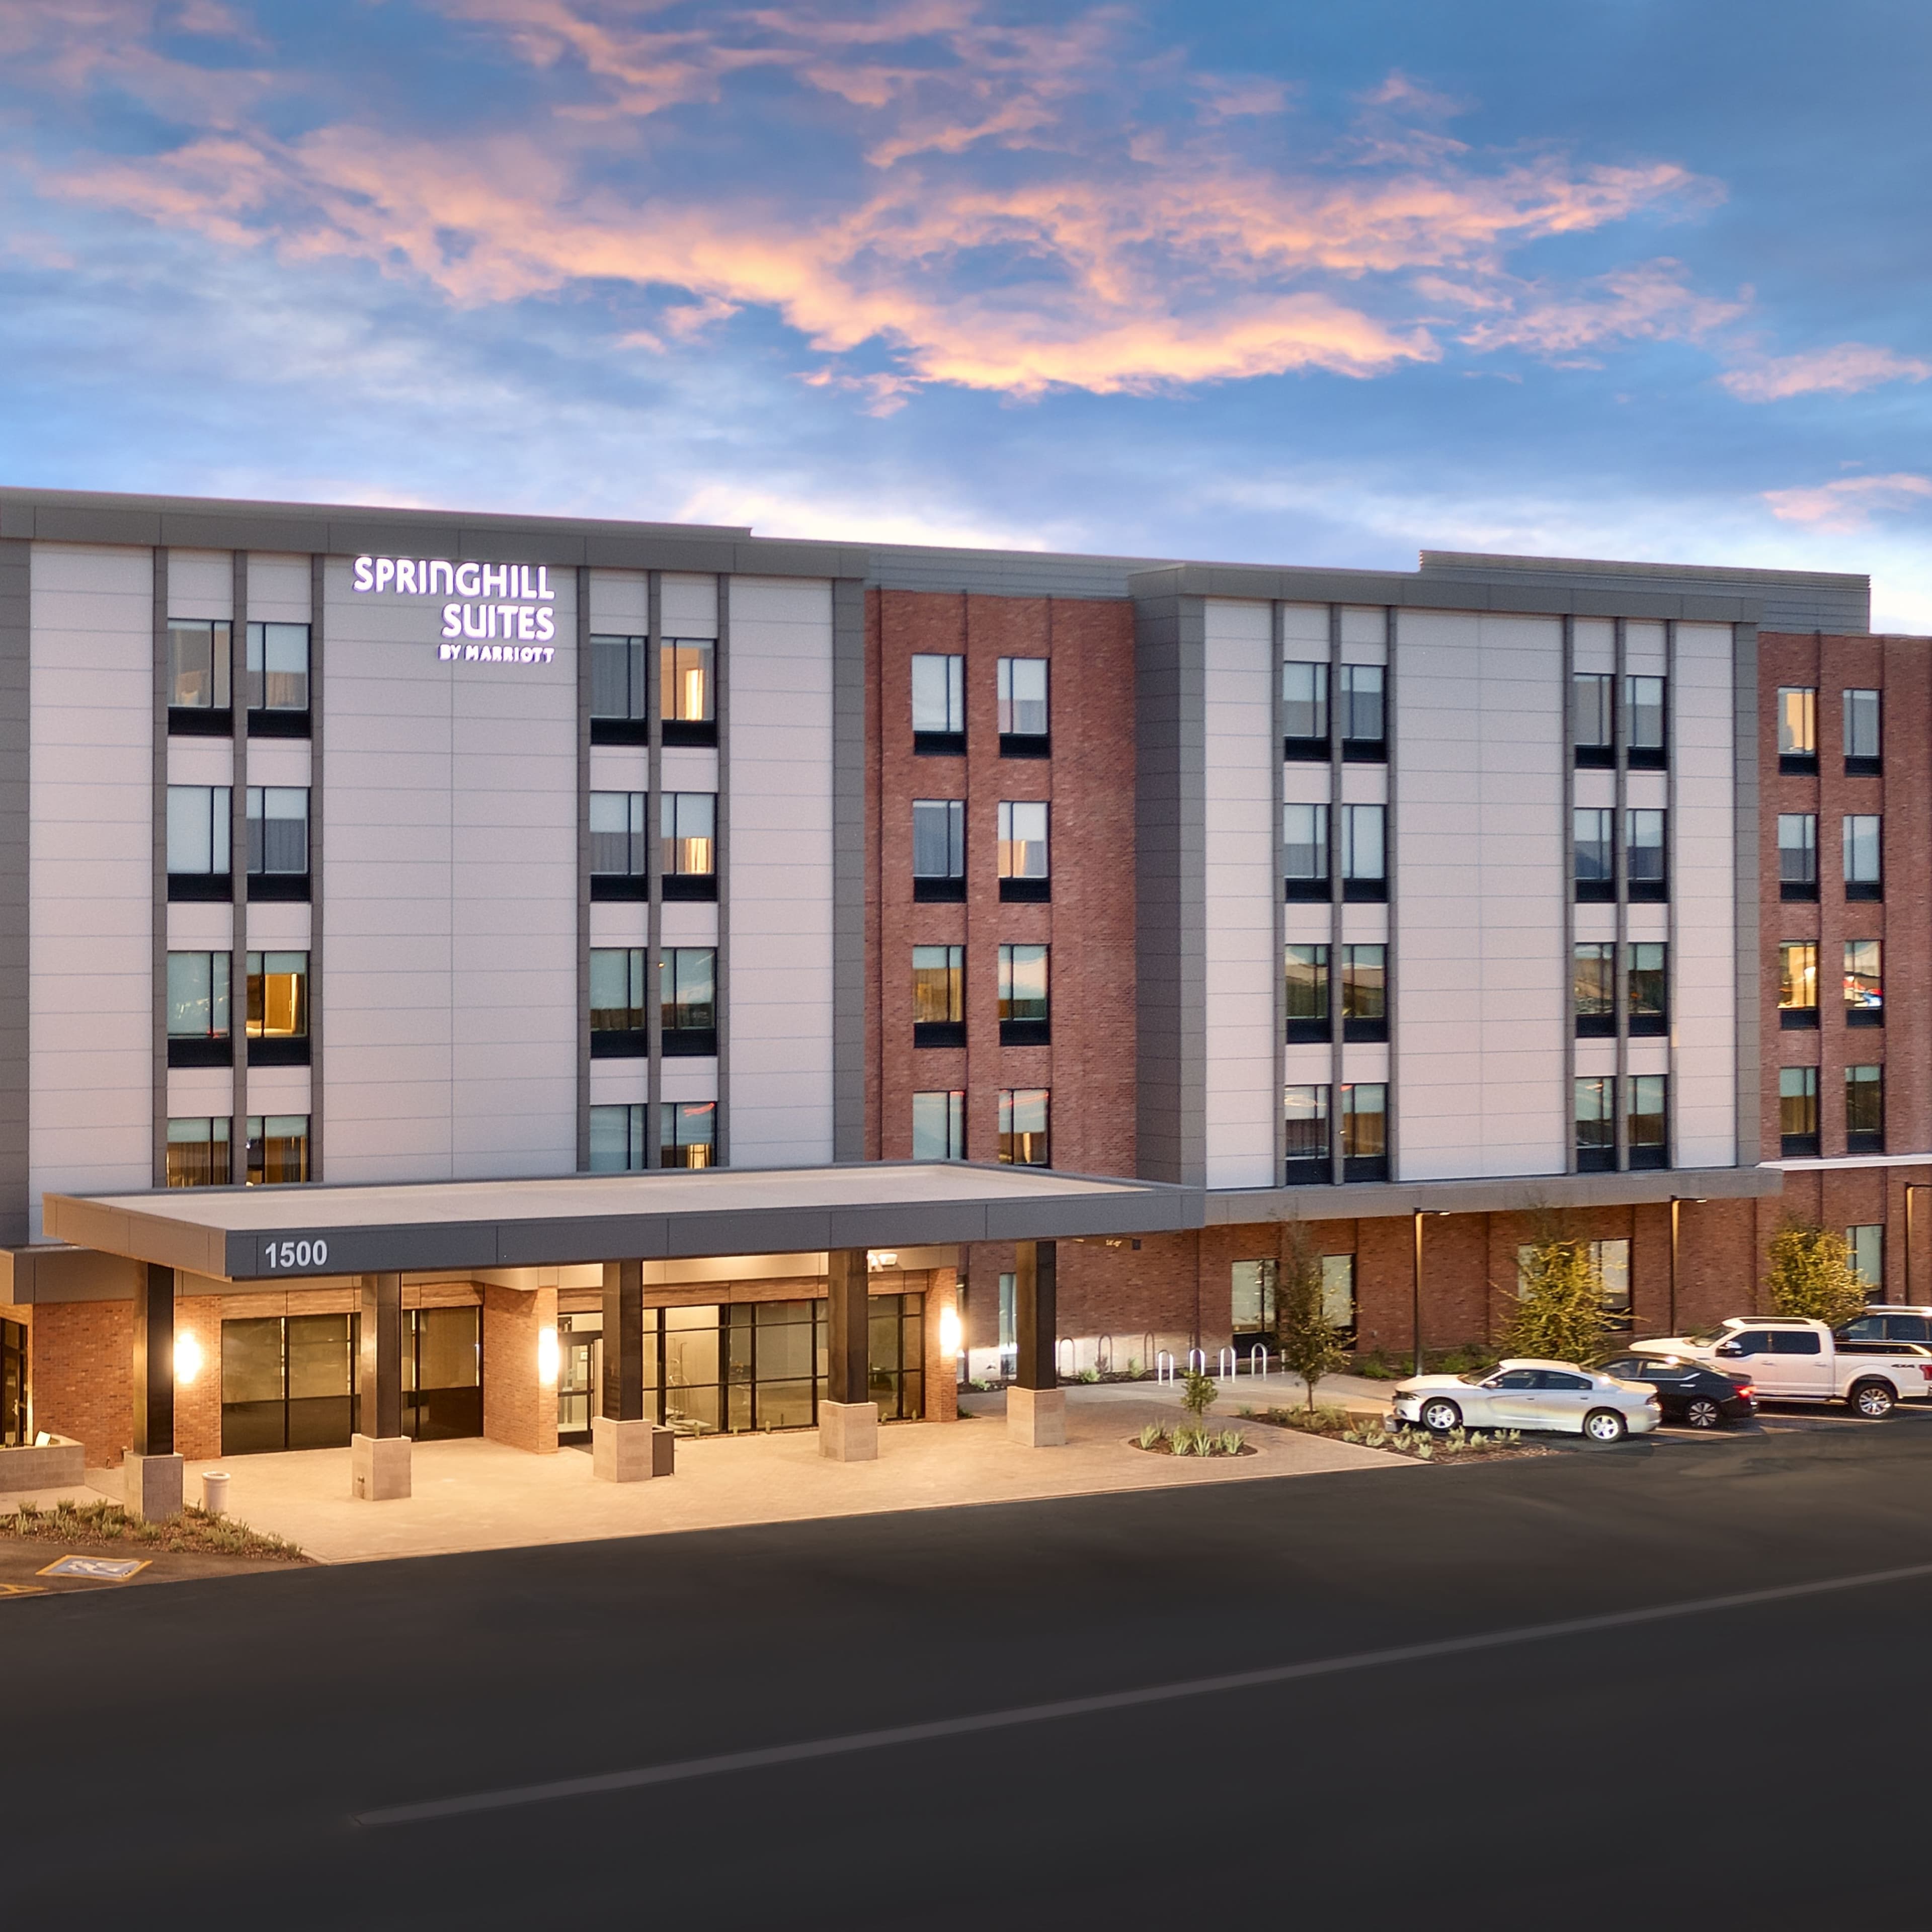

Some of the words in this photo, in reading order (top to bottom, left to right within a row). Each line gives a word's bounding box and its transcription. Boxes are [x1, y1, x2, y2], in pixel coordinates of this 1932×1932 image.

[353, 556, 554, 600] SPRINGHILL
[441, 603, 554, 640] SUITES
[439, 643, 461, 661] BY
[465, 645, 554, 663] MARRIOTT
[265, 1240, 328, 1268] 1500
